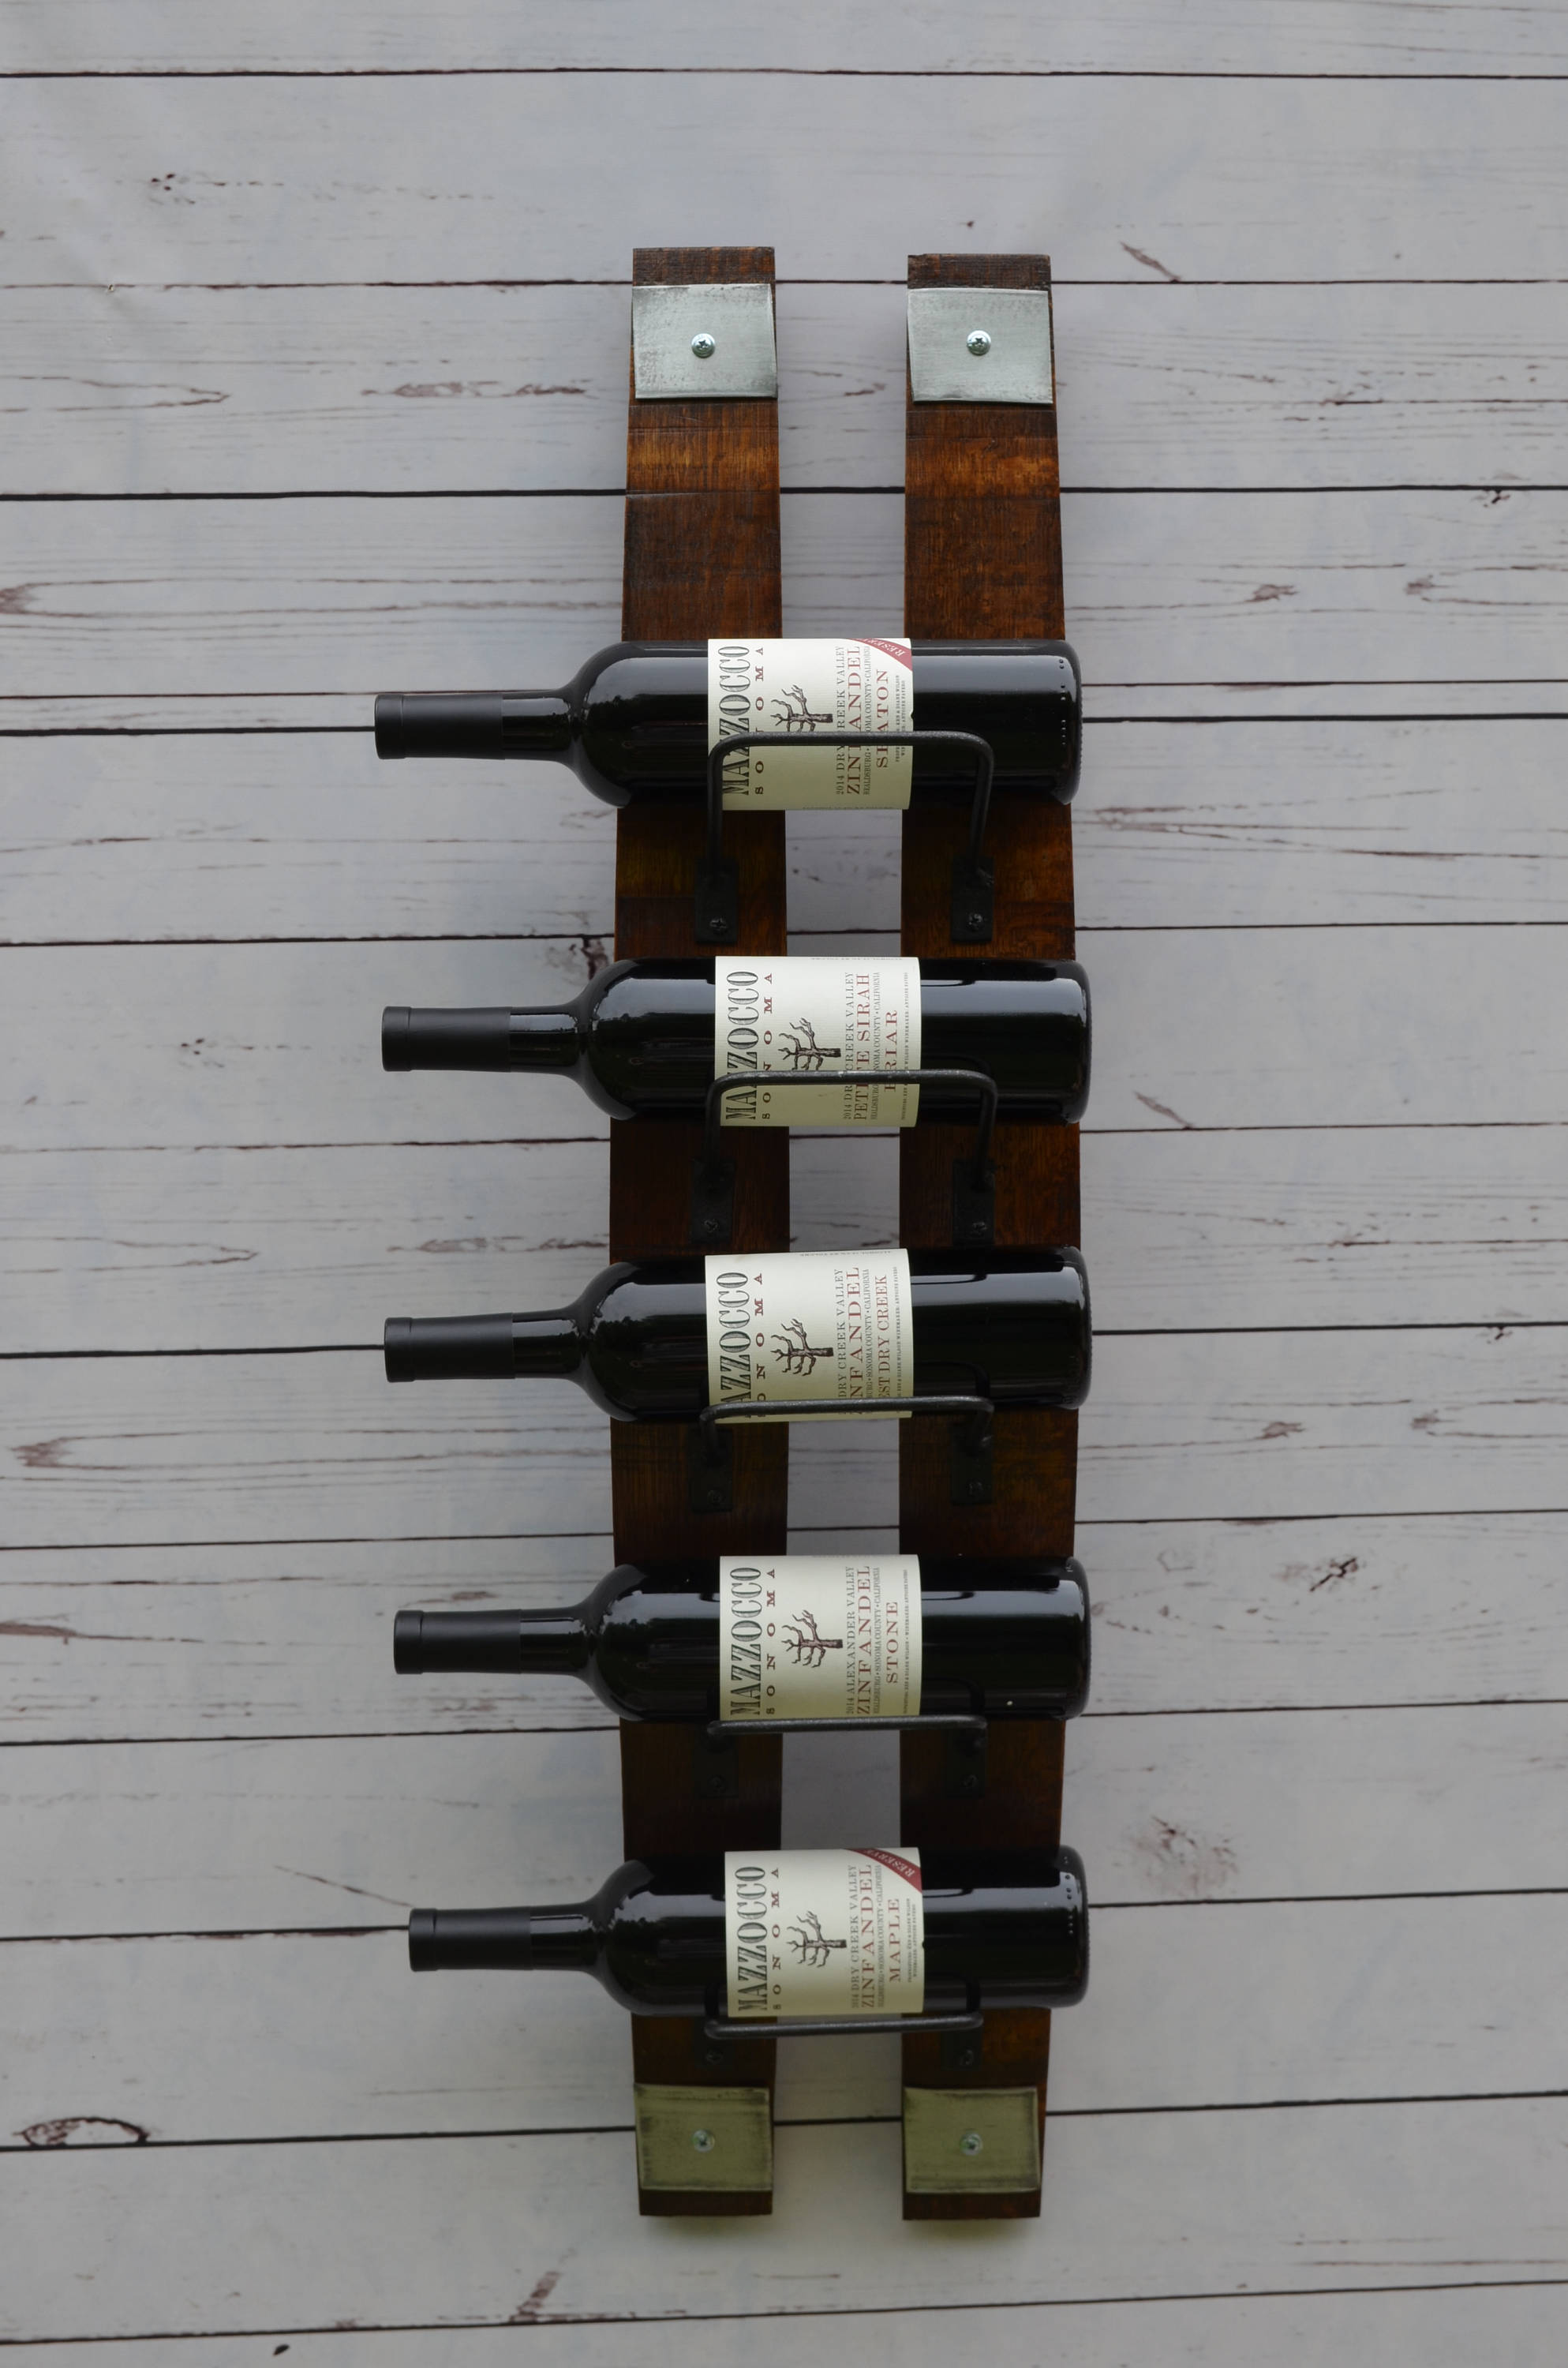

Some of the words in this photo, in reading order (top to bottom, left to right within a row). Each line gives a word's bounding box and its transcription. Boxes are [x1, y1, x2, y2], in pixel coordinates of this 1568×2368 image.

[755, 647, 764, 794] SOOMA
[836, 690, 845, 729] REEK
[726, 972, 759, 1119] MAZOCCO
[856, 973, 870, 1041] SIRAH
[855, 1051, 869, 1119] PETIE
[834, 1269, 844, 1316] VALLEY
[862, 1269, 870, 1309] CALIFORNIA
[875, 1275, 889, 1331] CREEK
[716, 1272, 750, 1418] AZZOCCO
[754, 1273, 765, 1417] ONOMA
[837, 1322, 846, 1369] CREEK
[847, 1267, 863, 1414] NFANDEL
[878, 1336, 890, 1373] DRY
[846, 1566, 855, 1607] VALLEY
[730, 1568, 762, 1715] MAZZOCCO
[766, 1568, 776, 1714] SONOMA
[857, 1566, 872, 1714] ZINFANDEL
[887, 1602, 898, 1684] STONE
[846, 1698, 855, 1714] 2014
[848, 1864, 858, 1910] VALLEY
[735, 1867, 767, 2010] MAZZOCCO
[771, 1868, 781, 2010] SONOMA
[859, 1864, 874, 2008] ZINFANDEL
[888, 1898, 900, 1982] MAPLE
